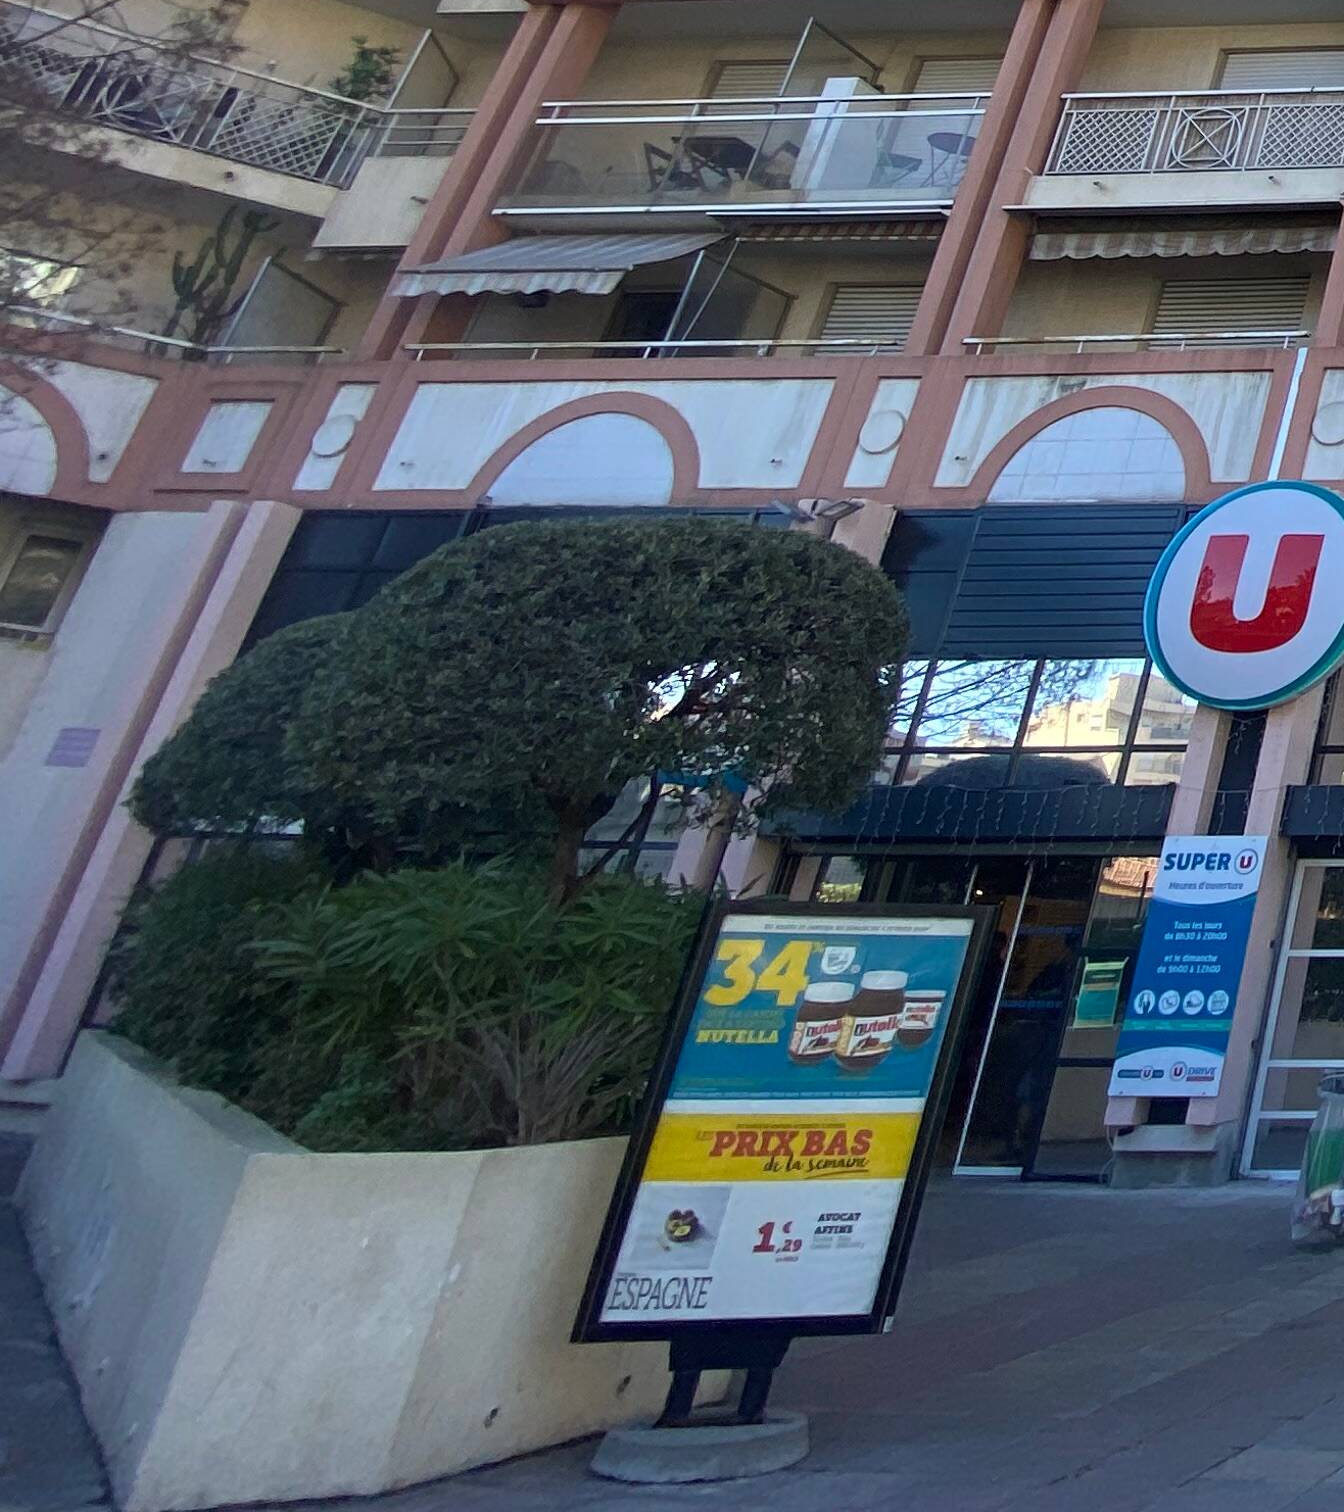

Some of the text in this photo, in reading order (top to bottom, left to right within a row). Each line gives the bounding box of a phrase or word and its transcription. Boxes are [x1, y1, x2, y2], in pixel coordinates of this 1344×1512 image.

[1189, 534, 1325, 653] U
[1163, 852, 1232, 871] SUPER
[1168, 881, 1245, 890] Heures d'ouverture
[1182, 953, 1218, 962] dimanche
[696, 1029, 779, 1044] NUTELLA
[709, 1130, 799, 1157] PRIX
[801, 1129, 873, 1156] BAS
[762, 1152, 870, 1172] de la semaine
[817, 1212, 862, 1222] AVOCAT
[607, 1276, 713, 1311] ESPAGNE
